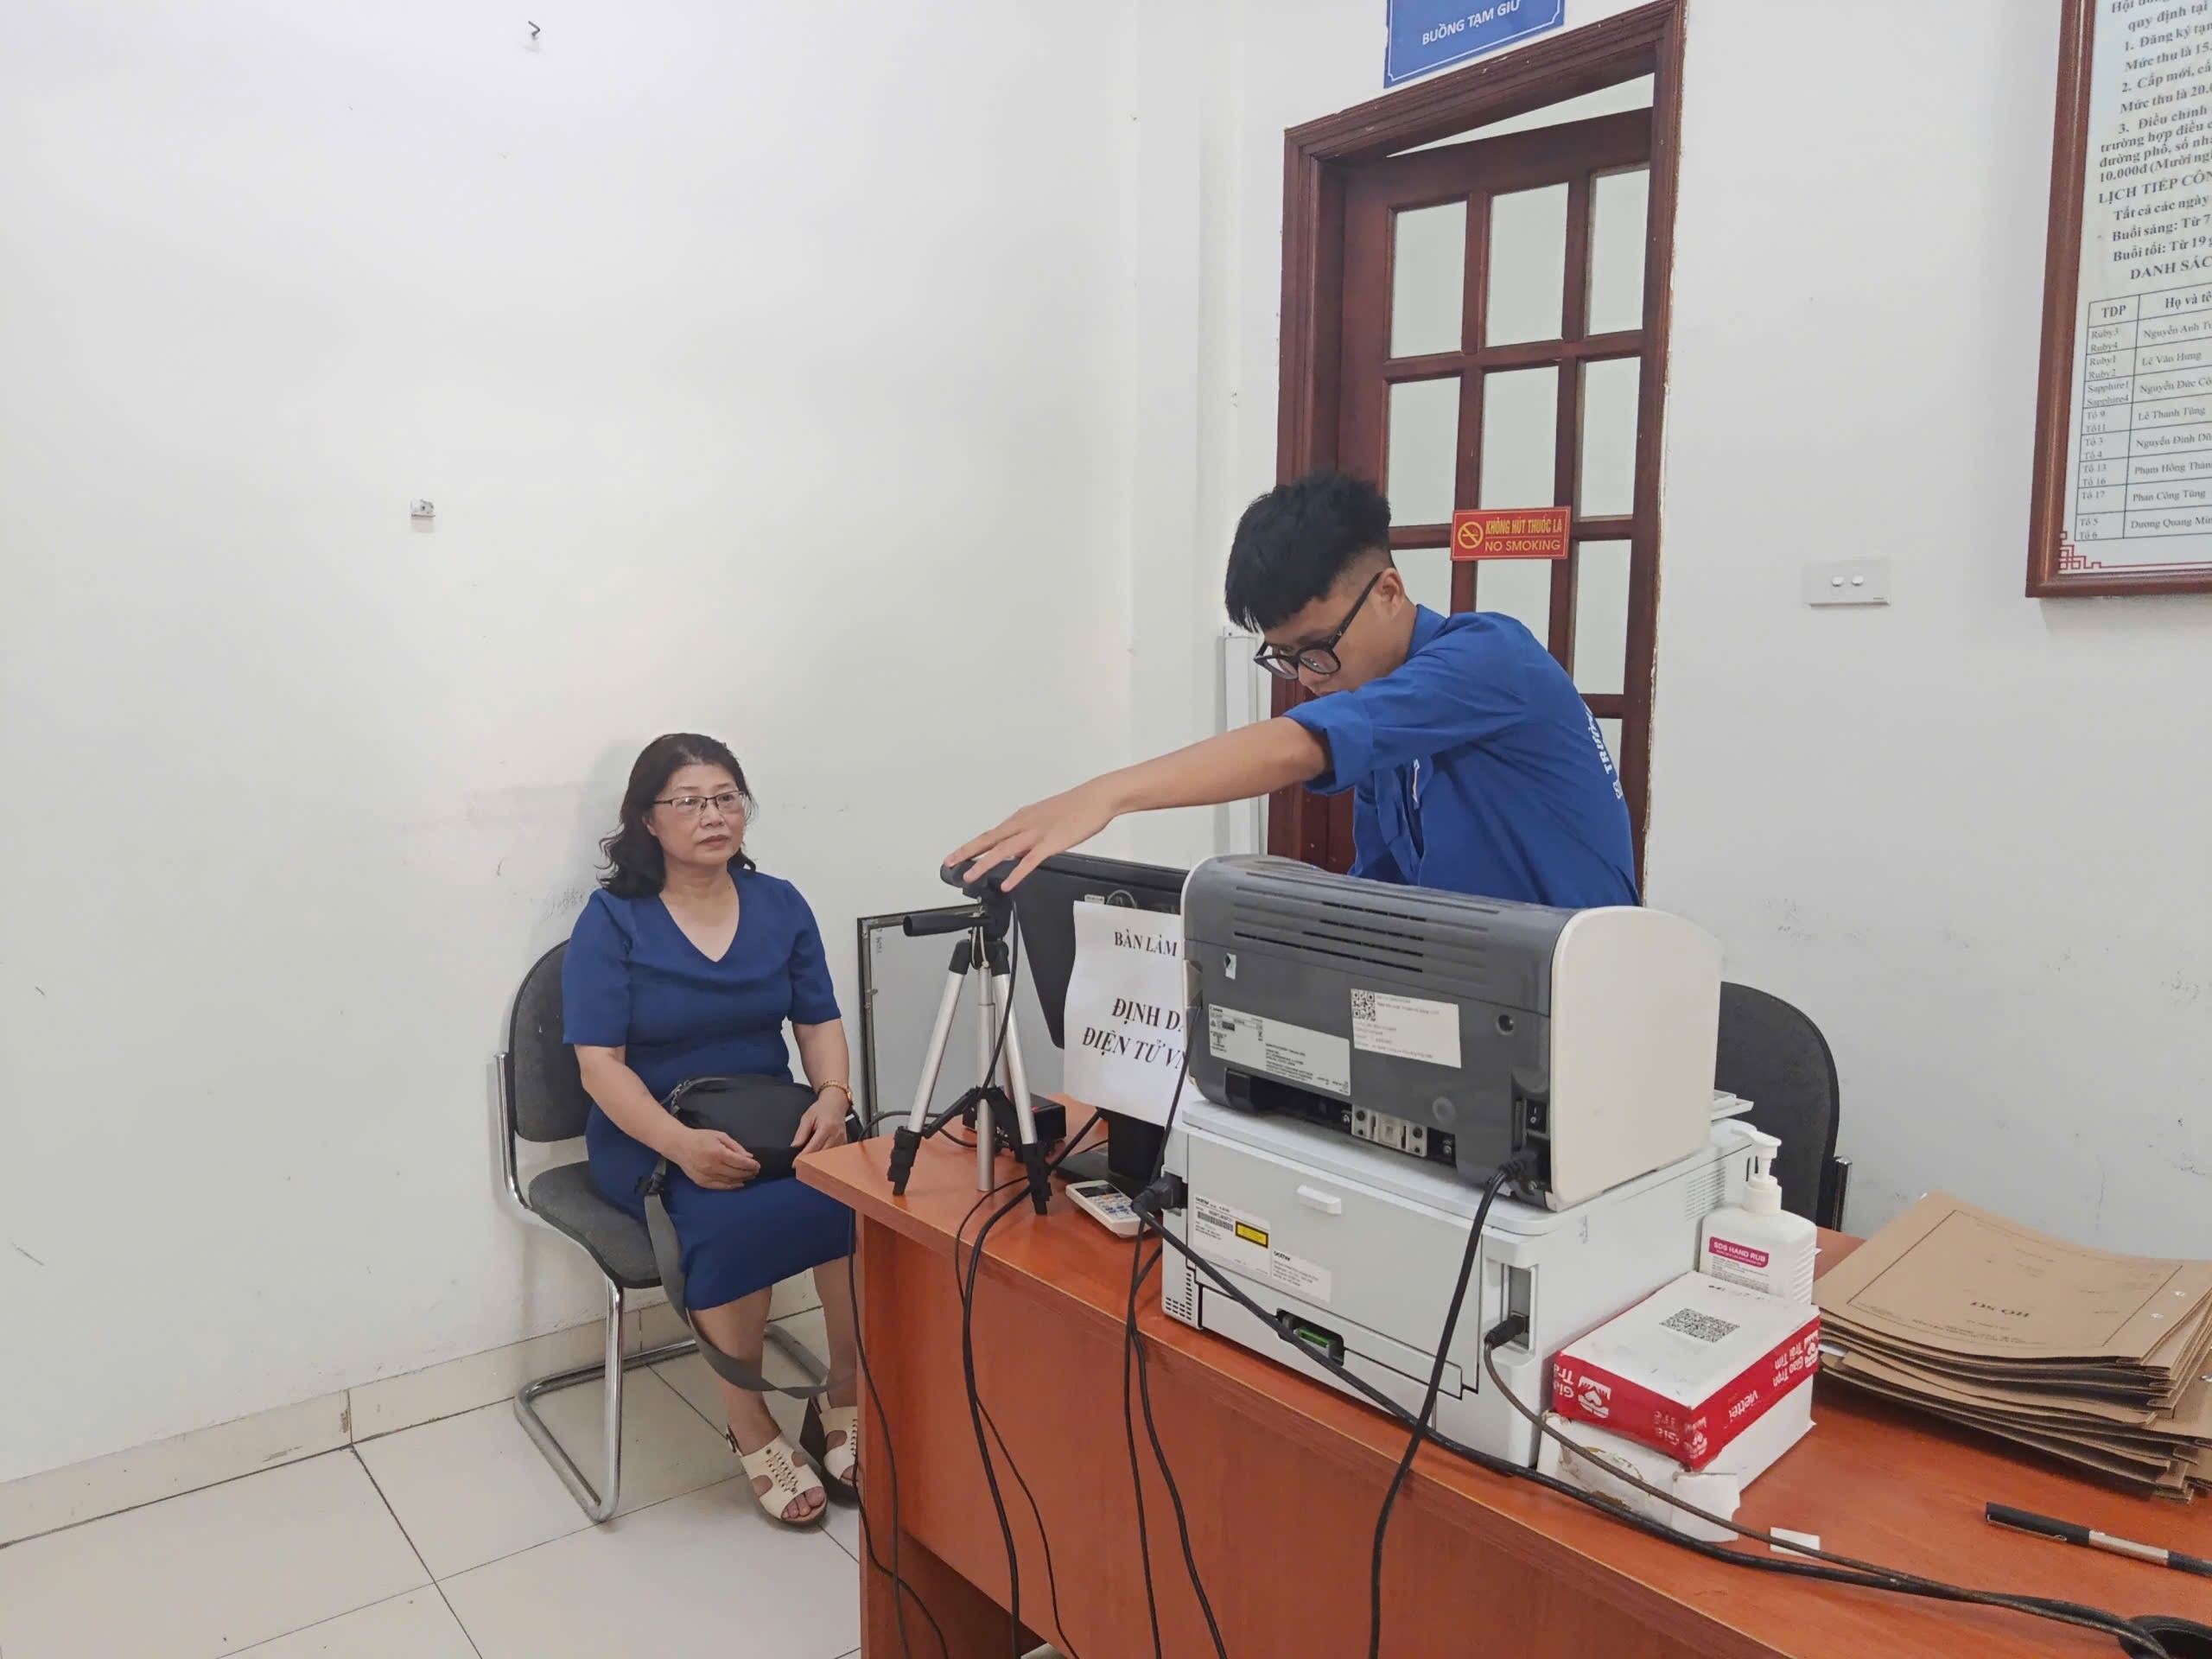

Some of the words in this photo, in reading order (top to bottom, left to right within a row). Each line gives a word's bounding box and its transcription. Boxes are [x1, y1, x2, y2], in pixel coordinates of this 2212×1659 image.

[1422, 19, 1465, 45] BUỒNG
[1467, 8, 1494, 28] TẠM
[2128, 17, 2152, 32] quy
[2157, 6, 2187, 23] định
[2140, 32, 2173, 48] Đăng
[2125, 57, 2154, 71] Mức
[2157, 52, 2177, 63] thu
[2181, 46, 2191, 58] là
[2121, 82, 2132, 92] 2.
[2137, 72, 2163, 88] Cấp
[2120, 99, 2149, 114] Mức
[2152, 94, 2173, 105] thu
[2176, 88, 2187, 100] là
[2118, 124, 2129, 134] 3.
[2139, 112, 2167, 130] Điều
[2101, 137, 2144, 153] trường
[2148, 130, 2172, 143] hợp
[2176, 120, 2203, 137] điều
[2100, 153, 2140, 168] đường
[2175, 137, 2189, 151] số
[2101, 163, 2147, 182] 10.000đ
[2150, 154, 2190, 173] (Mười
[2098, 186, 2137, 205] LỊCH
[2113, 207, 2135, 220] Tất
[2138, 204, 2152, 216] cả
[2154, 200, 2175, 213] các
[2178, 194, 2209, 209] ngày
[2113, 225, 2141, 242] Buổi
[2144, 222, 2177, 235] sáng:
[2181, 216, 2201, 228] Từ
[2113, 245, 2142, 262] Buổi
[2145, 242, 2166, 257] tối:
[2170, 238, 2189, 251] Từ
[2192, 235, 2207, 248] 19
[2130, 263, 2176, 280] DANH
[2101, 305, 2126, 318] TDP
[2165, 296, 2182, 309] Họ
[2185, 294, 2198, 305] và
[2143, 325, 2178, 340] Nguyễn
[2180, 323, 2200, 334] Anh
[2140, 380, 2175, 395] Nguyễn
[2152, 409, 2180, 420] Thanh
[2136, 435, 2171, 449] Nguyễn
[2134, 466, 2159, 476] Phạm
[2162, 462, 2185, 474] Hồng
[2133, 493, 2154, 503] Phan
[2156, 490, 2181, 501] Công
[1486, 517, 1510, 535] KHÔNG
[1512, 517, 1526, 534] HÚT
[1528, 513, 1552, 534] THUỐC
[2163, 518, 2193, 529] Quang
[1485, 540, 1503, 552] NO
[1506, 539, 1560, 551] SMOKING
[1115, 929, 1143, 950] BÀN
[1146, 934, 1177, 957] LÀM
[1112, 998, 1161, 1026] ĐỊNH
[1082, 1027, 1131, 1056] ĐIỆN
[1134, 1039, 1166, 1063] TỬ
[1728, 1246, 1749, 1258] HAND
[1750, 1252, 1766, 1262] RUB
